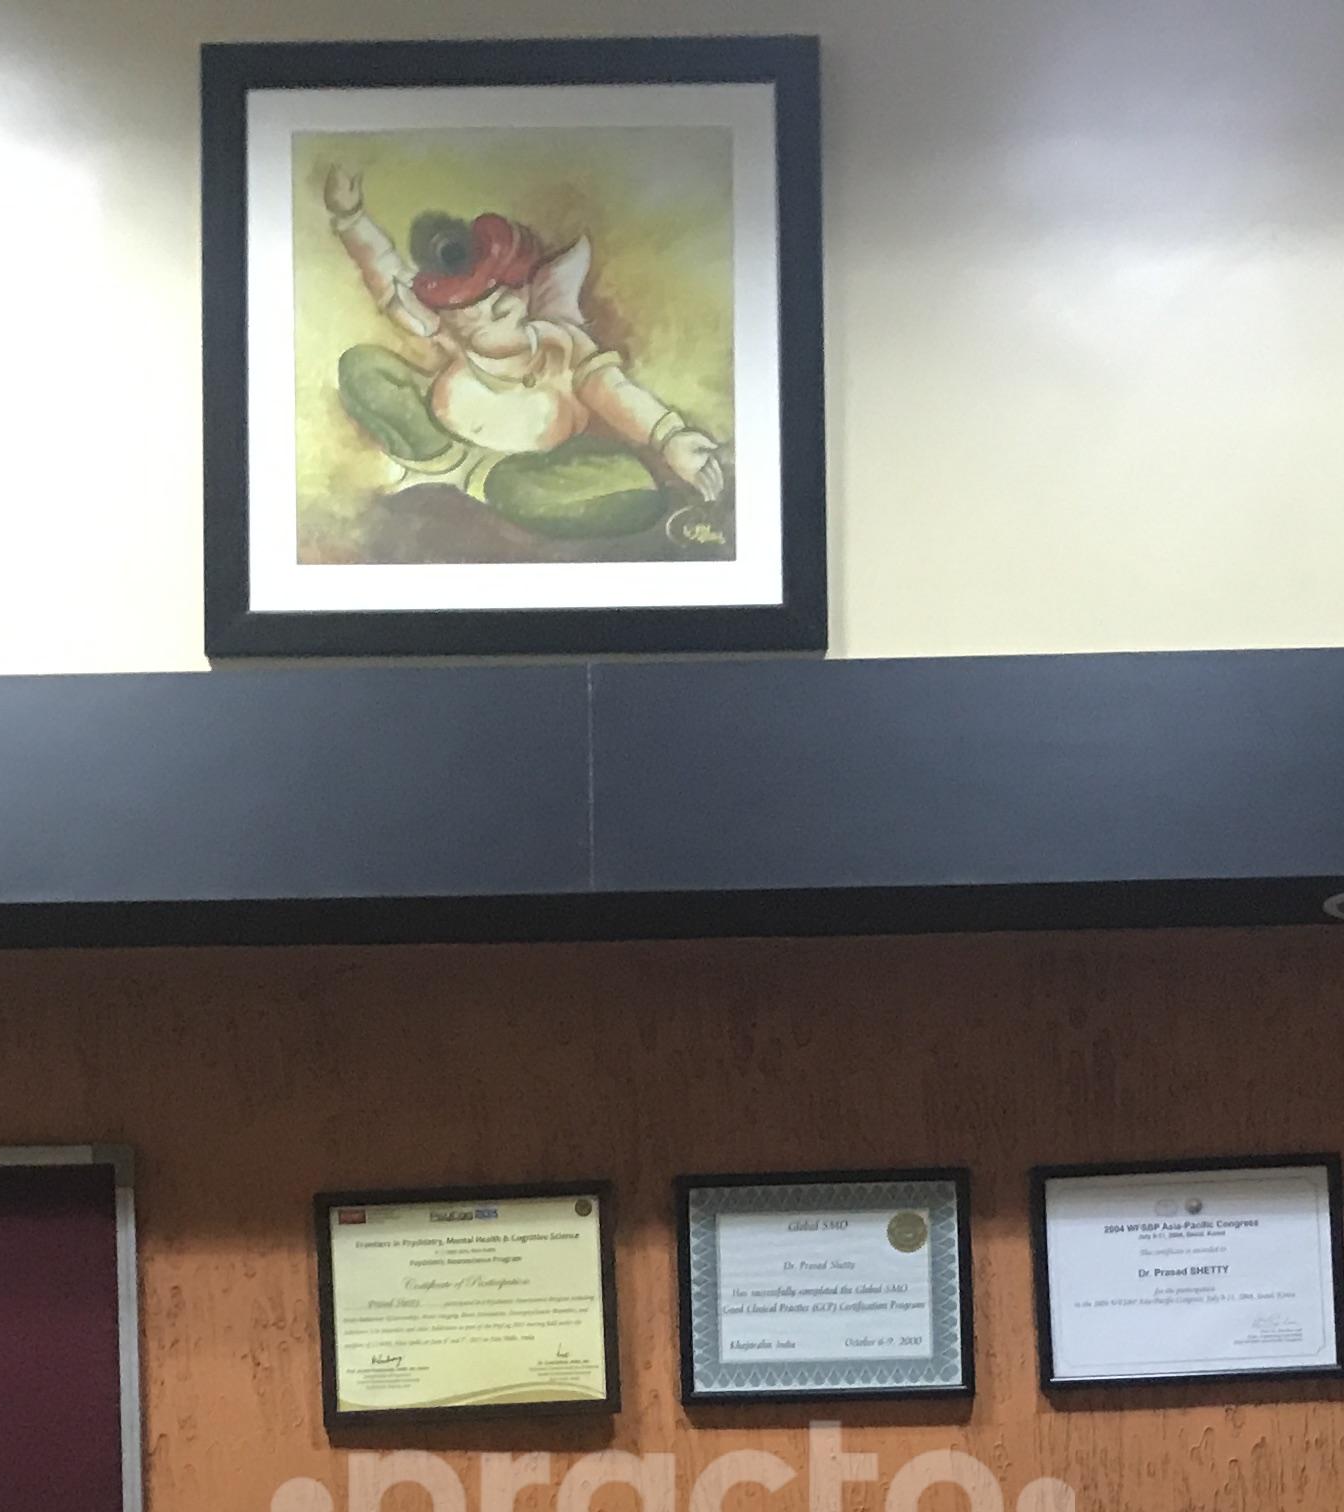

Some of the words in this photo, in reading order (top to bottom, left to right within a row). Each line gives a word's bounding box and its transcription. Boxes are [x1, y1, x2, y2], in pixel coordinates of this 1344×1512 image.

[788, 1220, 819, 1232] Global
[1104, 1225, 1125, 1234] 2004
[1161, 1220, 1214, 1231] Asia-Pacific
[1216, 1219, 1259, 1230] Congress
[446, 1235, 474, 1245] Mental
[475, 1234, 502, 1244] Health
[550, 1230, 580, 1241] Science
[1154, 1267, 1188, 1278] Prasad
[1190, 1264, 1229, 1277] SHETTY
[798, 1284, 838, 1297] completed
[840, 1284, 852, 1295] the
[746, 1302, 777, 1313] Clinical
[844, 1336, 875, 1347] October
